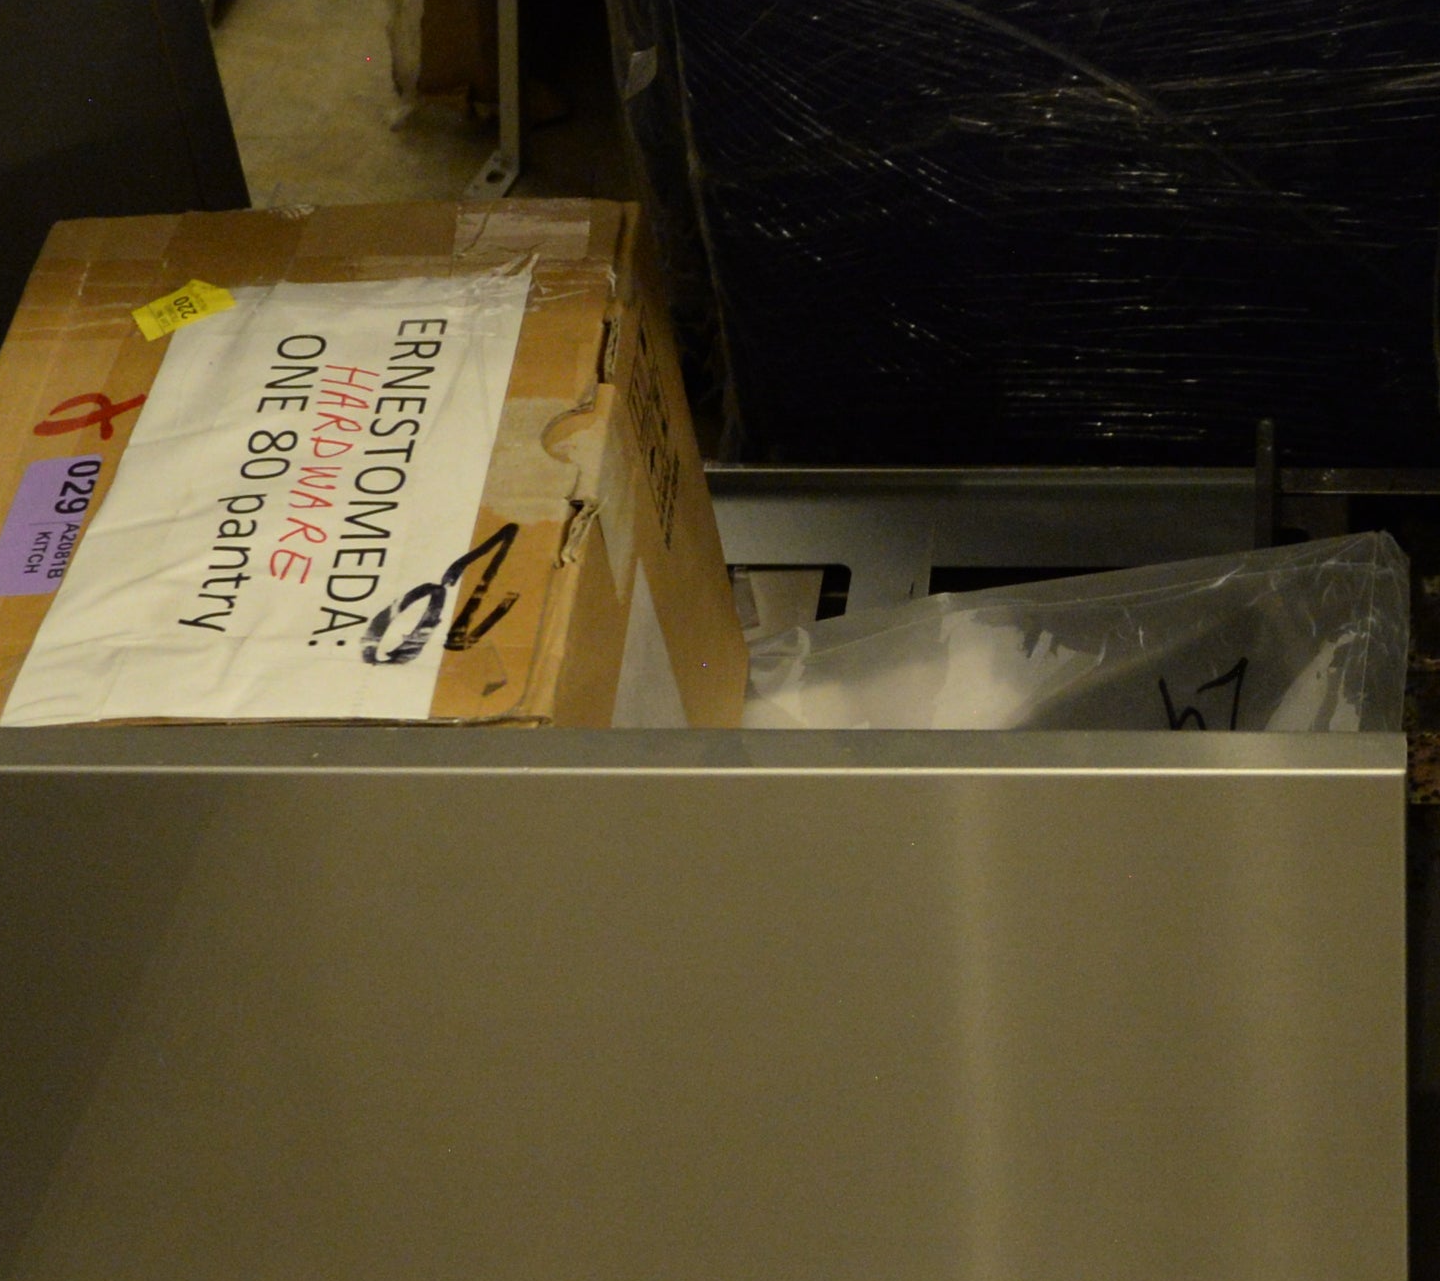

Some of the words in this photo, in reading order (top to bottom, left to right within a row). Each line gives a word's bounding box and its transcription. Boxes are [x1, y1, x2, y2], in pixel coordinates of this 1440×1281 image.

[254, 332, 327, 415] ONE
[54, 459, 102, 515] 029
[238, 429, 298, 479] 80
[265, 363, 381, 586] HARDWARE
[306, 317, 449, 651] ERNESTOMEDA:
[23, 531, 53, 574] KITCH
[46, 522, 81, 580] A2081B
[177, 493, 266, 633] pantry
